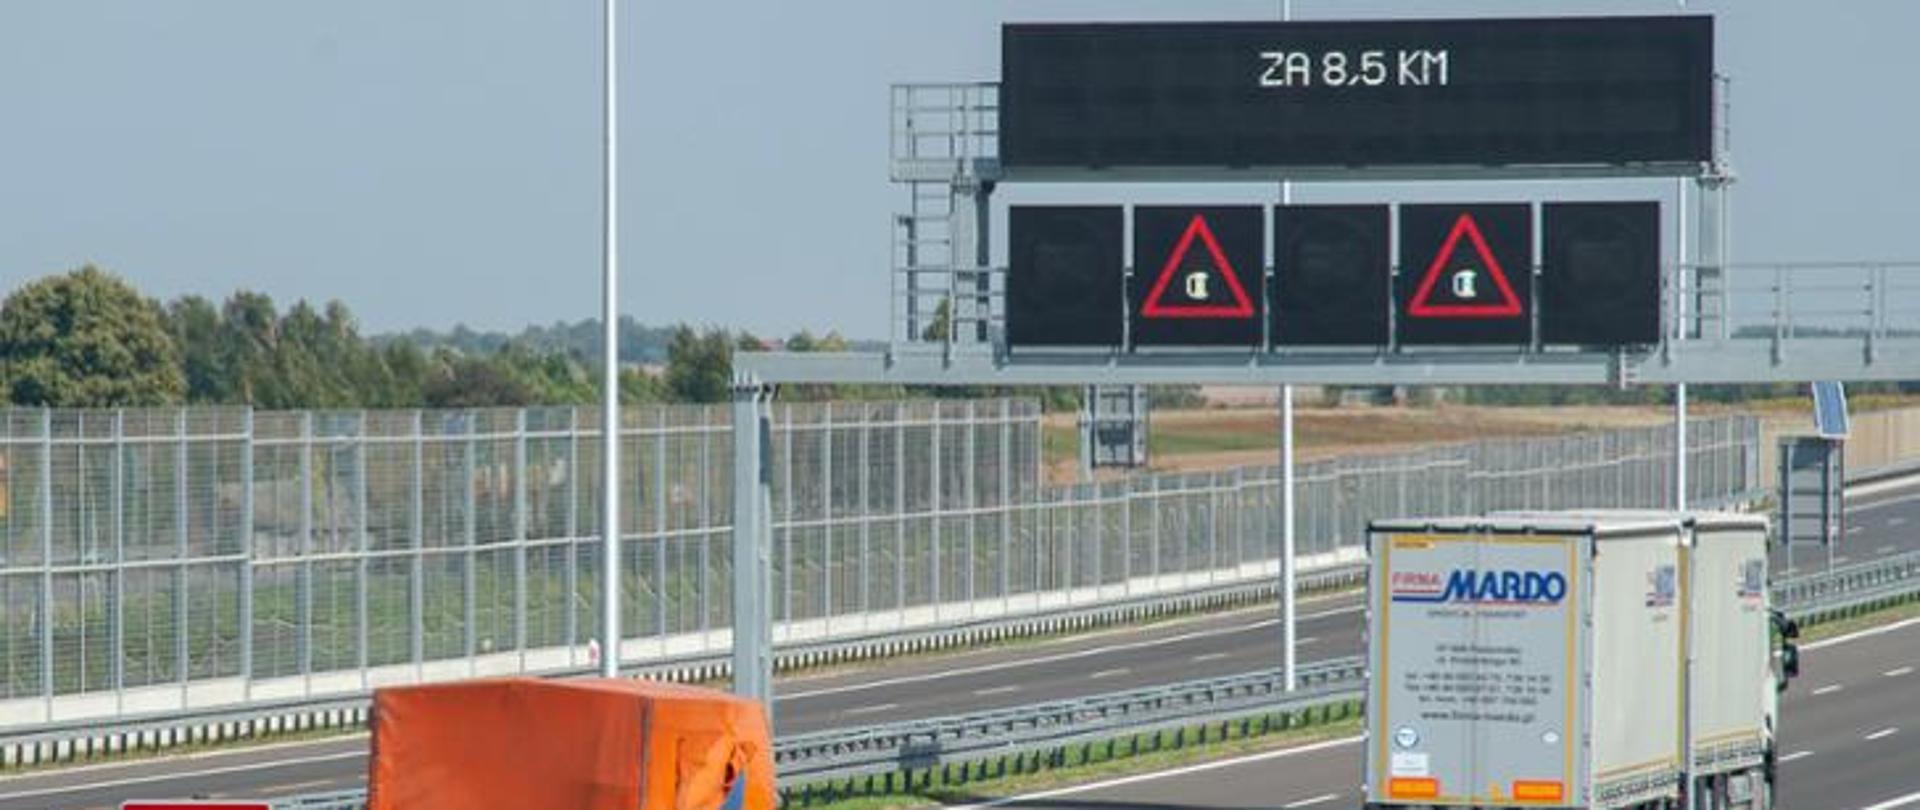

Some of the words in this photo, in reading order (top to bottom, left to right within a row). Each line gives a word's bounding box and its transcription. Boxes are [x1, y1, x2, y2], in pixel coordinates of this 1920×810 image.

[1259, 51, 1310, 87] ZA
[1322, 50, 1388, 87] 8,5
[1398, 50, 1449, 86] KM
[1391, 571, 1442, 587] FIRMA
[1444, 569, 1567, 602] MARDO
